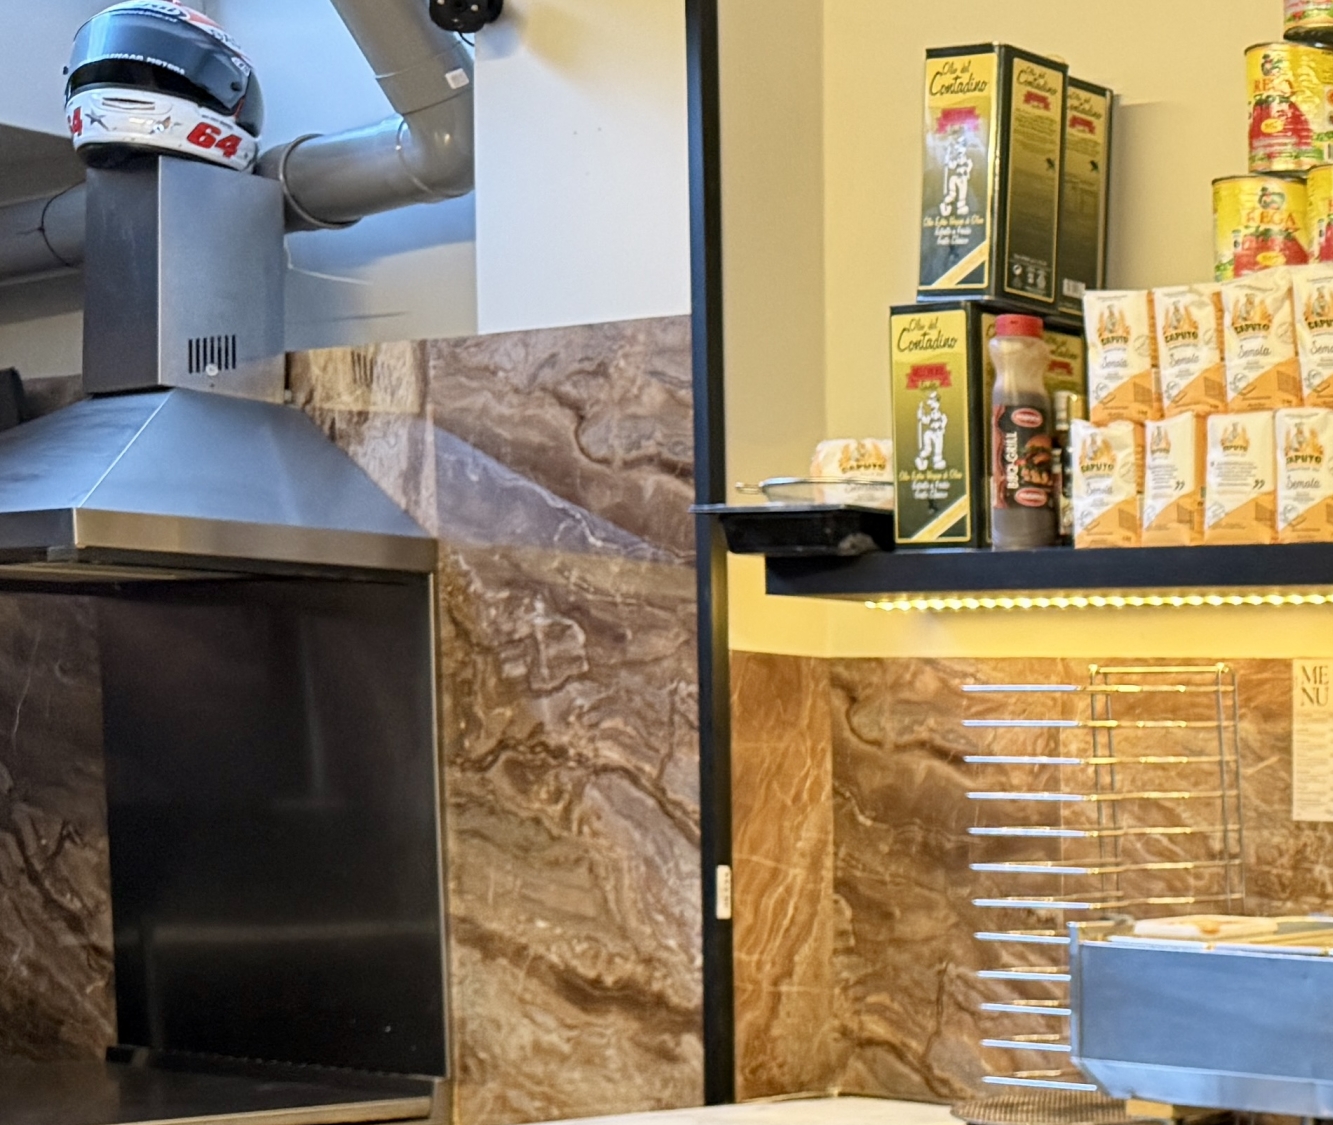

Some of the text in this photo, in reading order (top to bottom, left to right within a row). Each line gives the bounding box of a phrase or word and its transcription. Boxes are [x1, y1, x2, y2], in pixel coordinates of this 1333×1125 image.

[929, 71, 988, 97] Contadino
[187, 121, 243, 159] 64
[1233, 323, 1271, 335] CAPUTO
[896, 327, 958, 353] Contadino
[1236, 343, 1272, 360] Semola
[1285, 453, 1323, 465] CAPUTO
[1285, 475, 1321, 490] Semola
[1300, 665, 1330, 686] ME
[1300, 686, 1330, 708] NU
